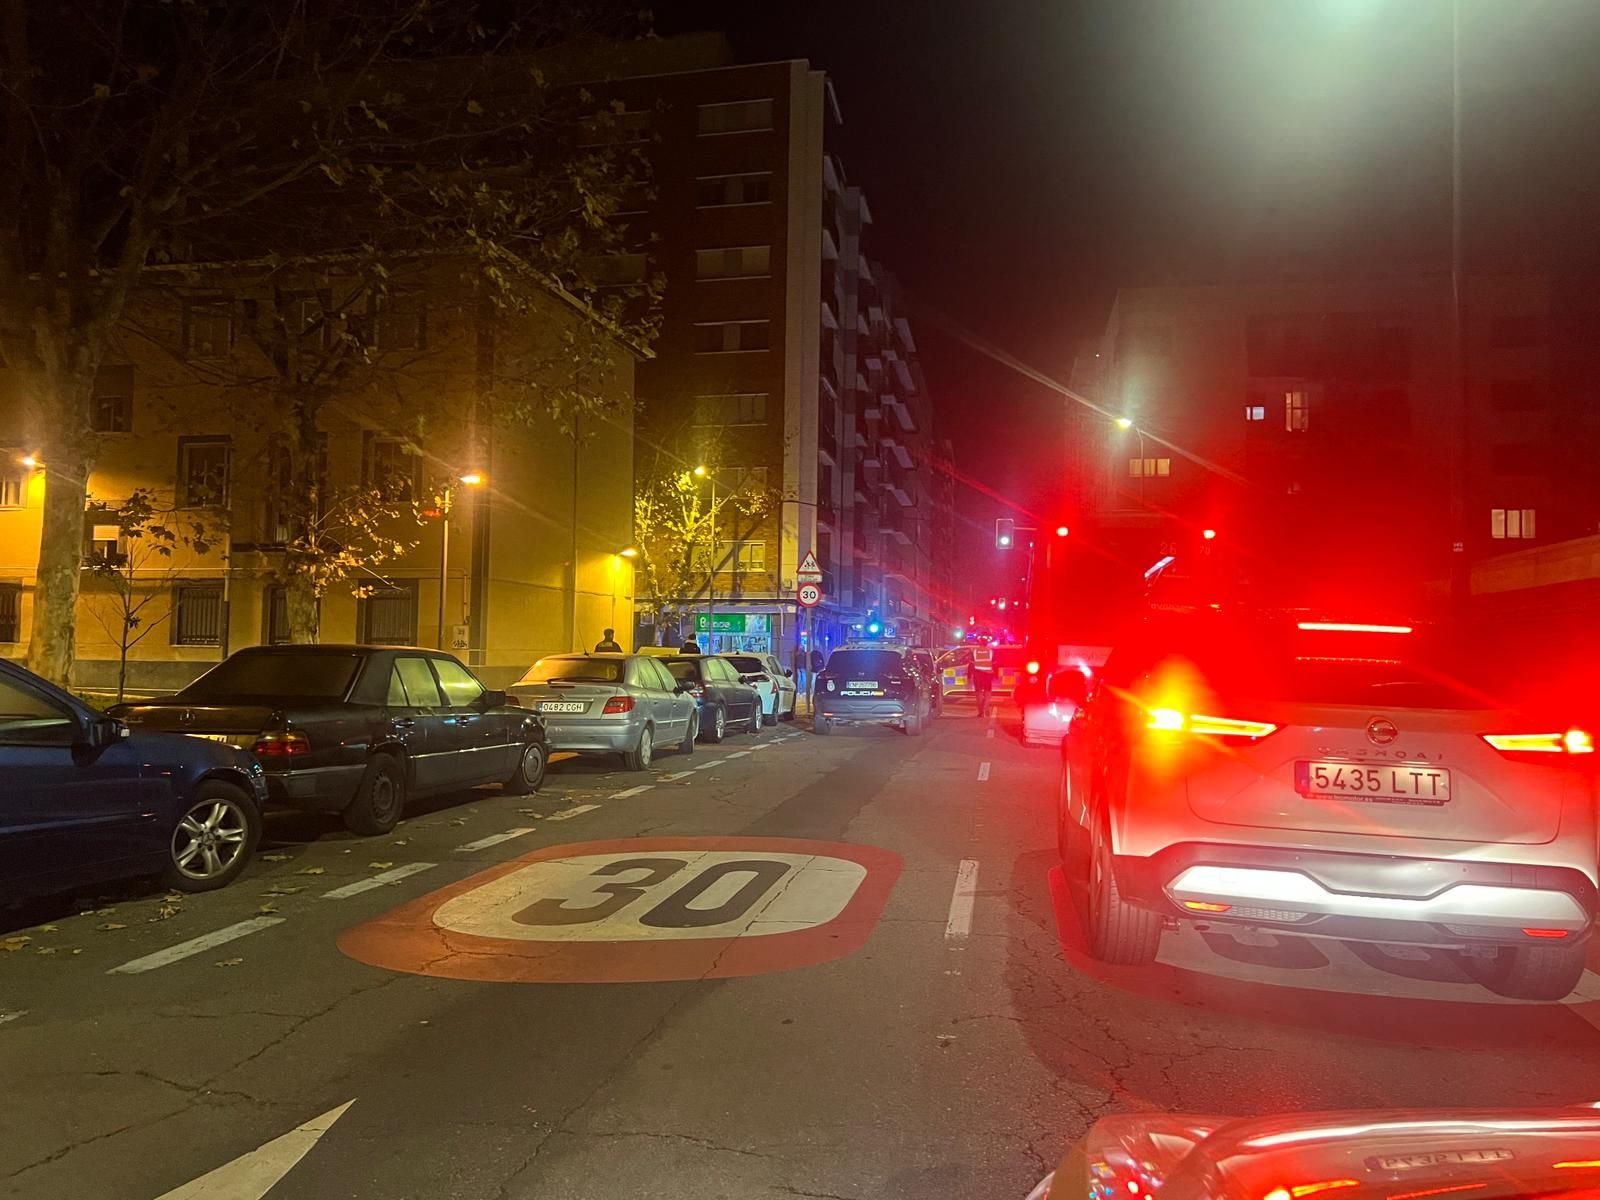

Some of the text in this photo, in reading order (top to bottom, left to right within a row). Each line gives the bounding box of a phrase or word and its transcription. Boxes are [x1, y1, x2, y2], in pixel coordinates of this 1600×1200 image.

[802, 590, 817, 600] 30
[543, 703, 582, 712] 0482 CGH
[1315, 767, 1441, 796] 5435 LTT
[511, 857, 792, 928] 30
